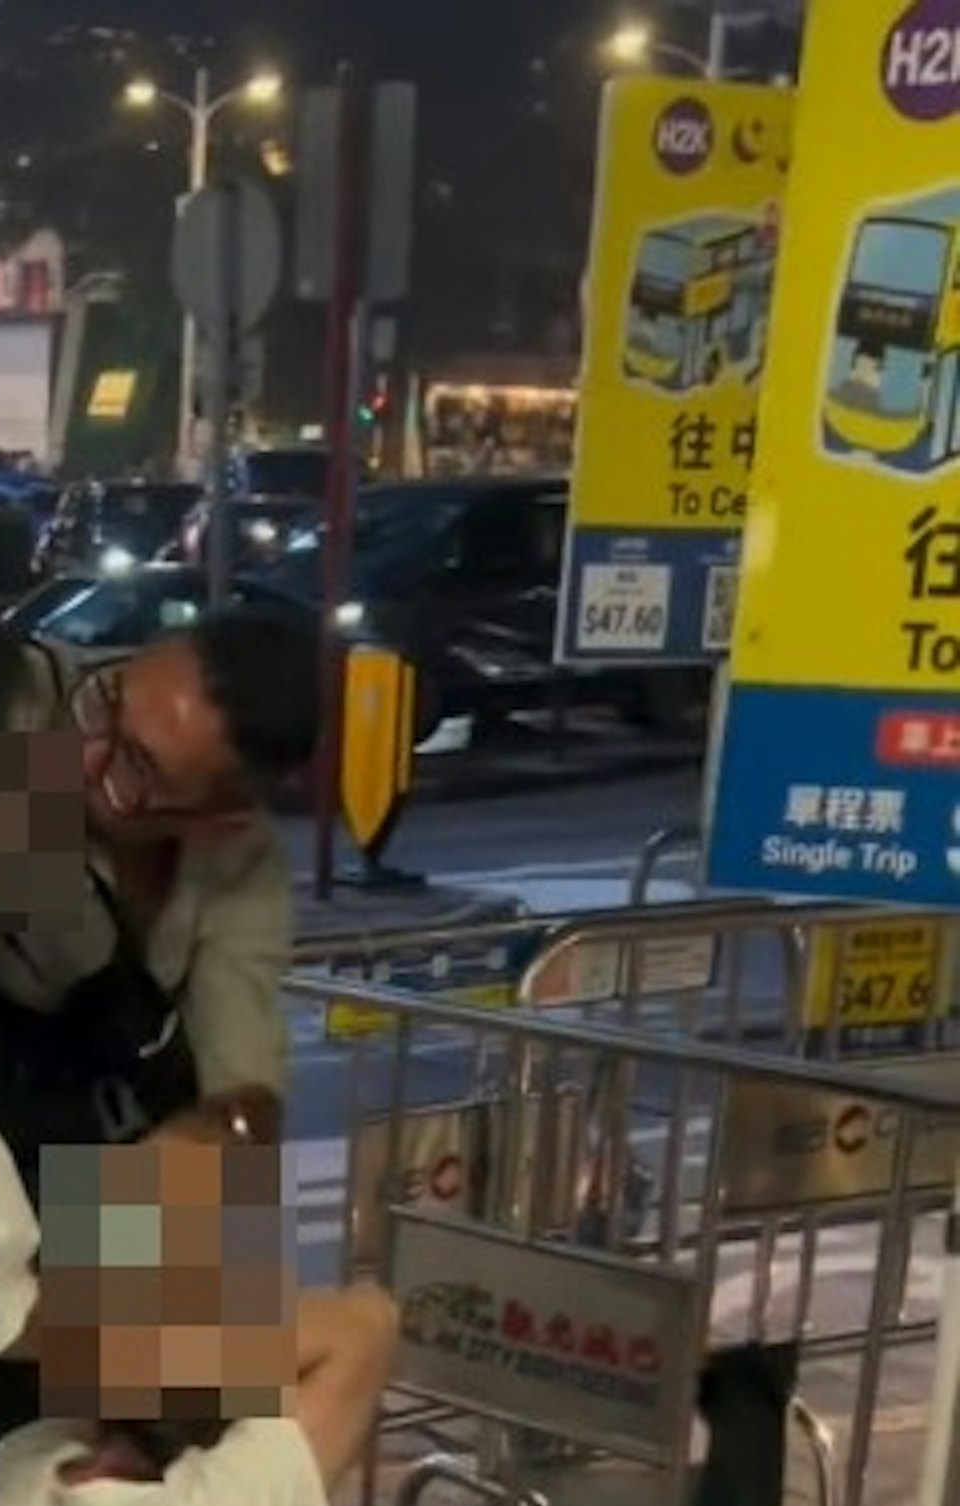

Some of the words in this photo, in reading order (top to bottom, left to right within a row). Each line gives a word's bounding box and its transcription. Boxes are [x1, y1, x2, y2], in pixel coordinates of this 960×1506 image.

[885, 28, 960, 87] H2
[669, 484, 700, 516] To
[583, 604, 663, 634] $47.60
[902, 622, 960, 673] To
[762, 835, 852, 874] Single
[860, 843, 919, 880] Trip
